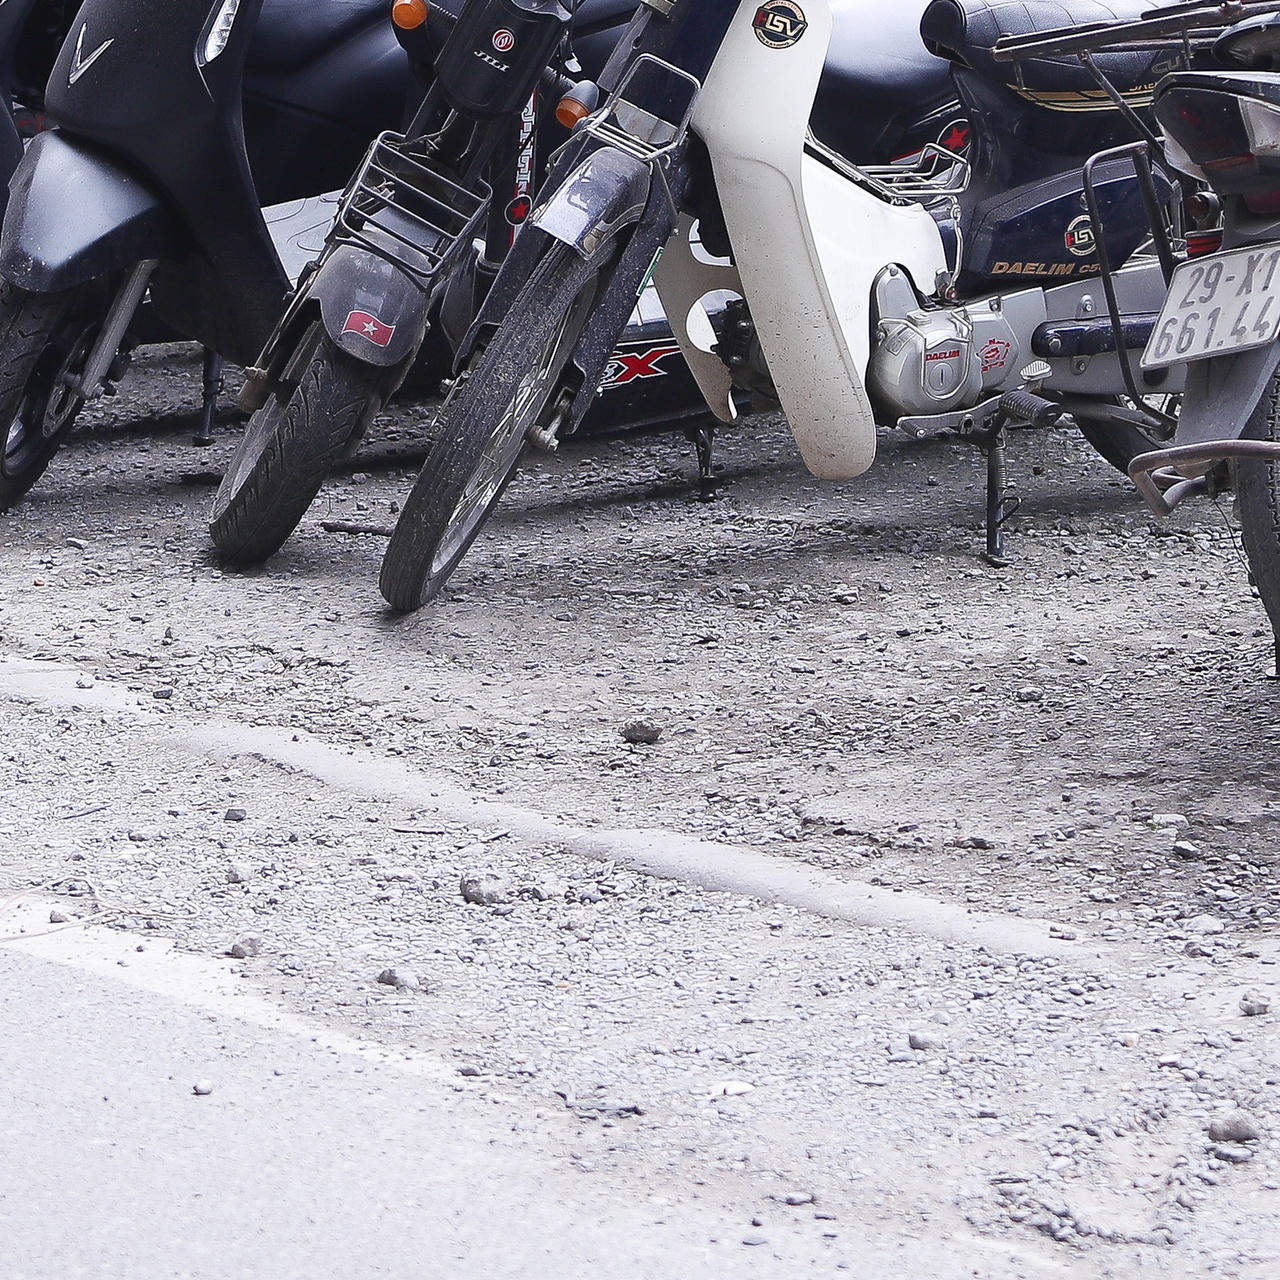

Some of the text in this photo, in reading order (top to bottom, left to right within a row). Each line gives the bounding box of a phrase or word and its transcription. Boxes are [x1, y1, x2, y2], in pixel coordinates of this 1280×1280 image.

[992, 261, 1076, 275] DAELIM
[1154, 296, 1274, 359] 661.44
[925, 349, 960, 362] DAELIM
